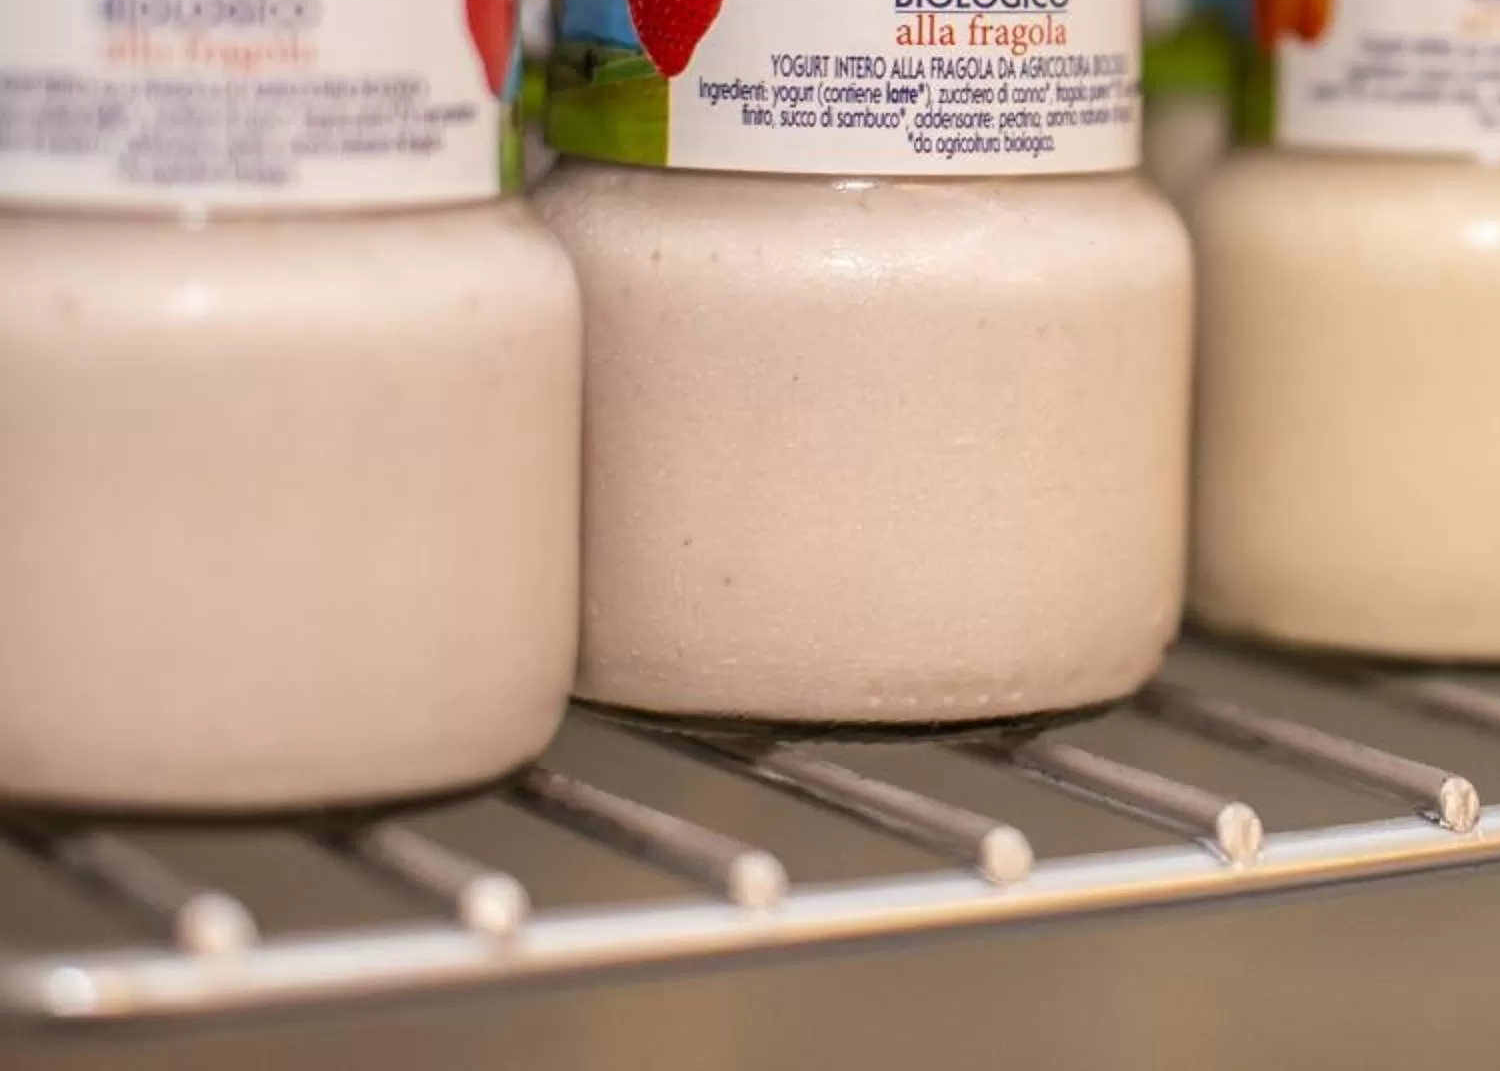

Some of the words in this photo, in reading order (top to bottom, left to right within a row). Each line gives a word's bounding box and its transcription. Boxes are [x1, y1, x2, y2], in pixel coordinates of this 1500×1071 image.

[896, 14, 956, 46] alla
[968, 12, 1068, 56] fragola
[771, 54, 830, 78] YOGURT
[834, 56, 886, 79] INTERO
[891, 57, 926, 80] ALLA
[930, 57, 994, 80] FRAGOLA
[998, 56, 1017, 79] DA
[1019, 55, 1091, 79] AGRICOLTURA
[699, 76, 769, 106] Ingredienti:
[771, 83, 815, 108] yogurt
[817, 81, 882, 106] (contiene
[938, 82, 994, 104] zucchero
[997, 82, 1008, 104] di
[780, 109, 816, 127] succo
[820, 106, 832, 127] di
[914, 107, 994, 129] addensante:
[936, 132, 1000, 159] agricoltura
